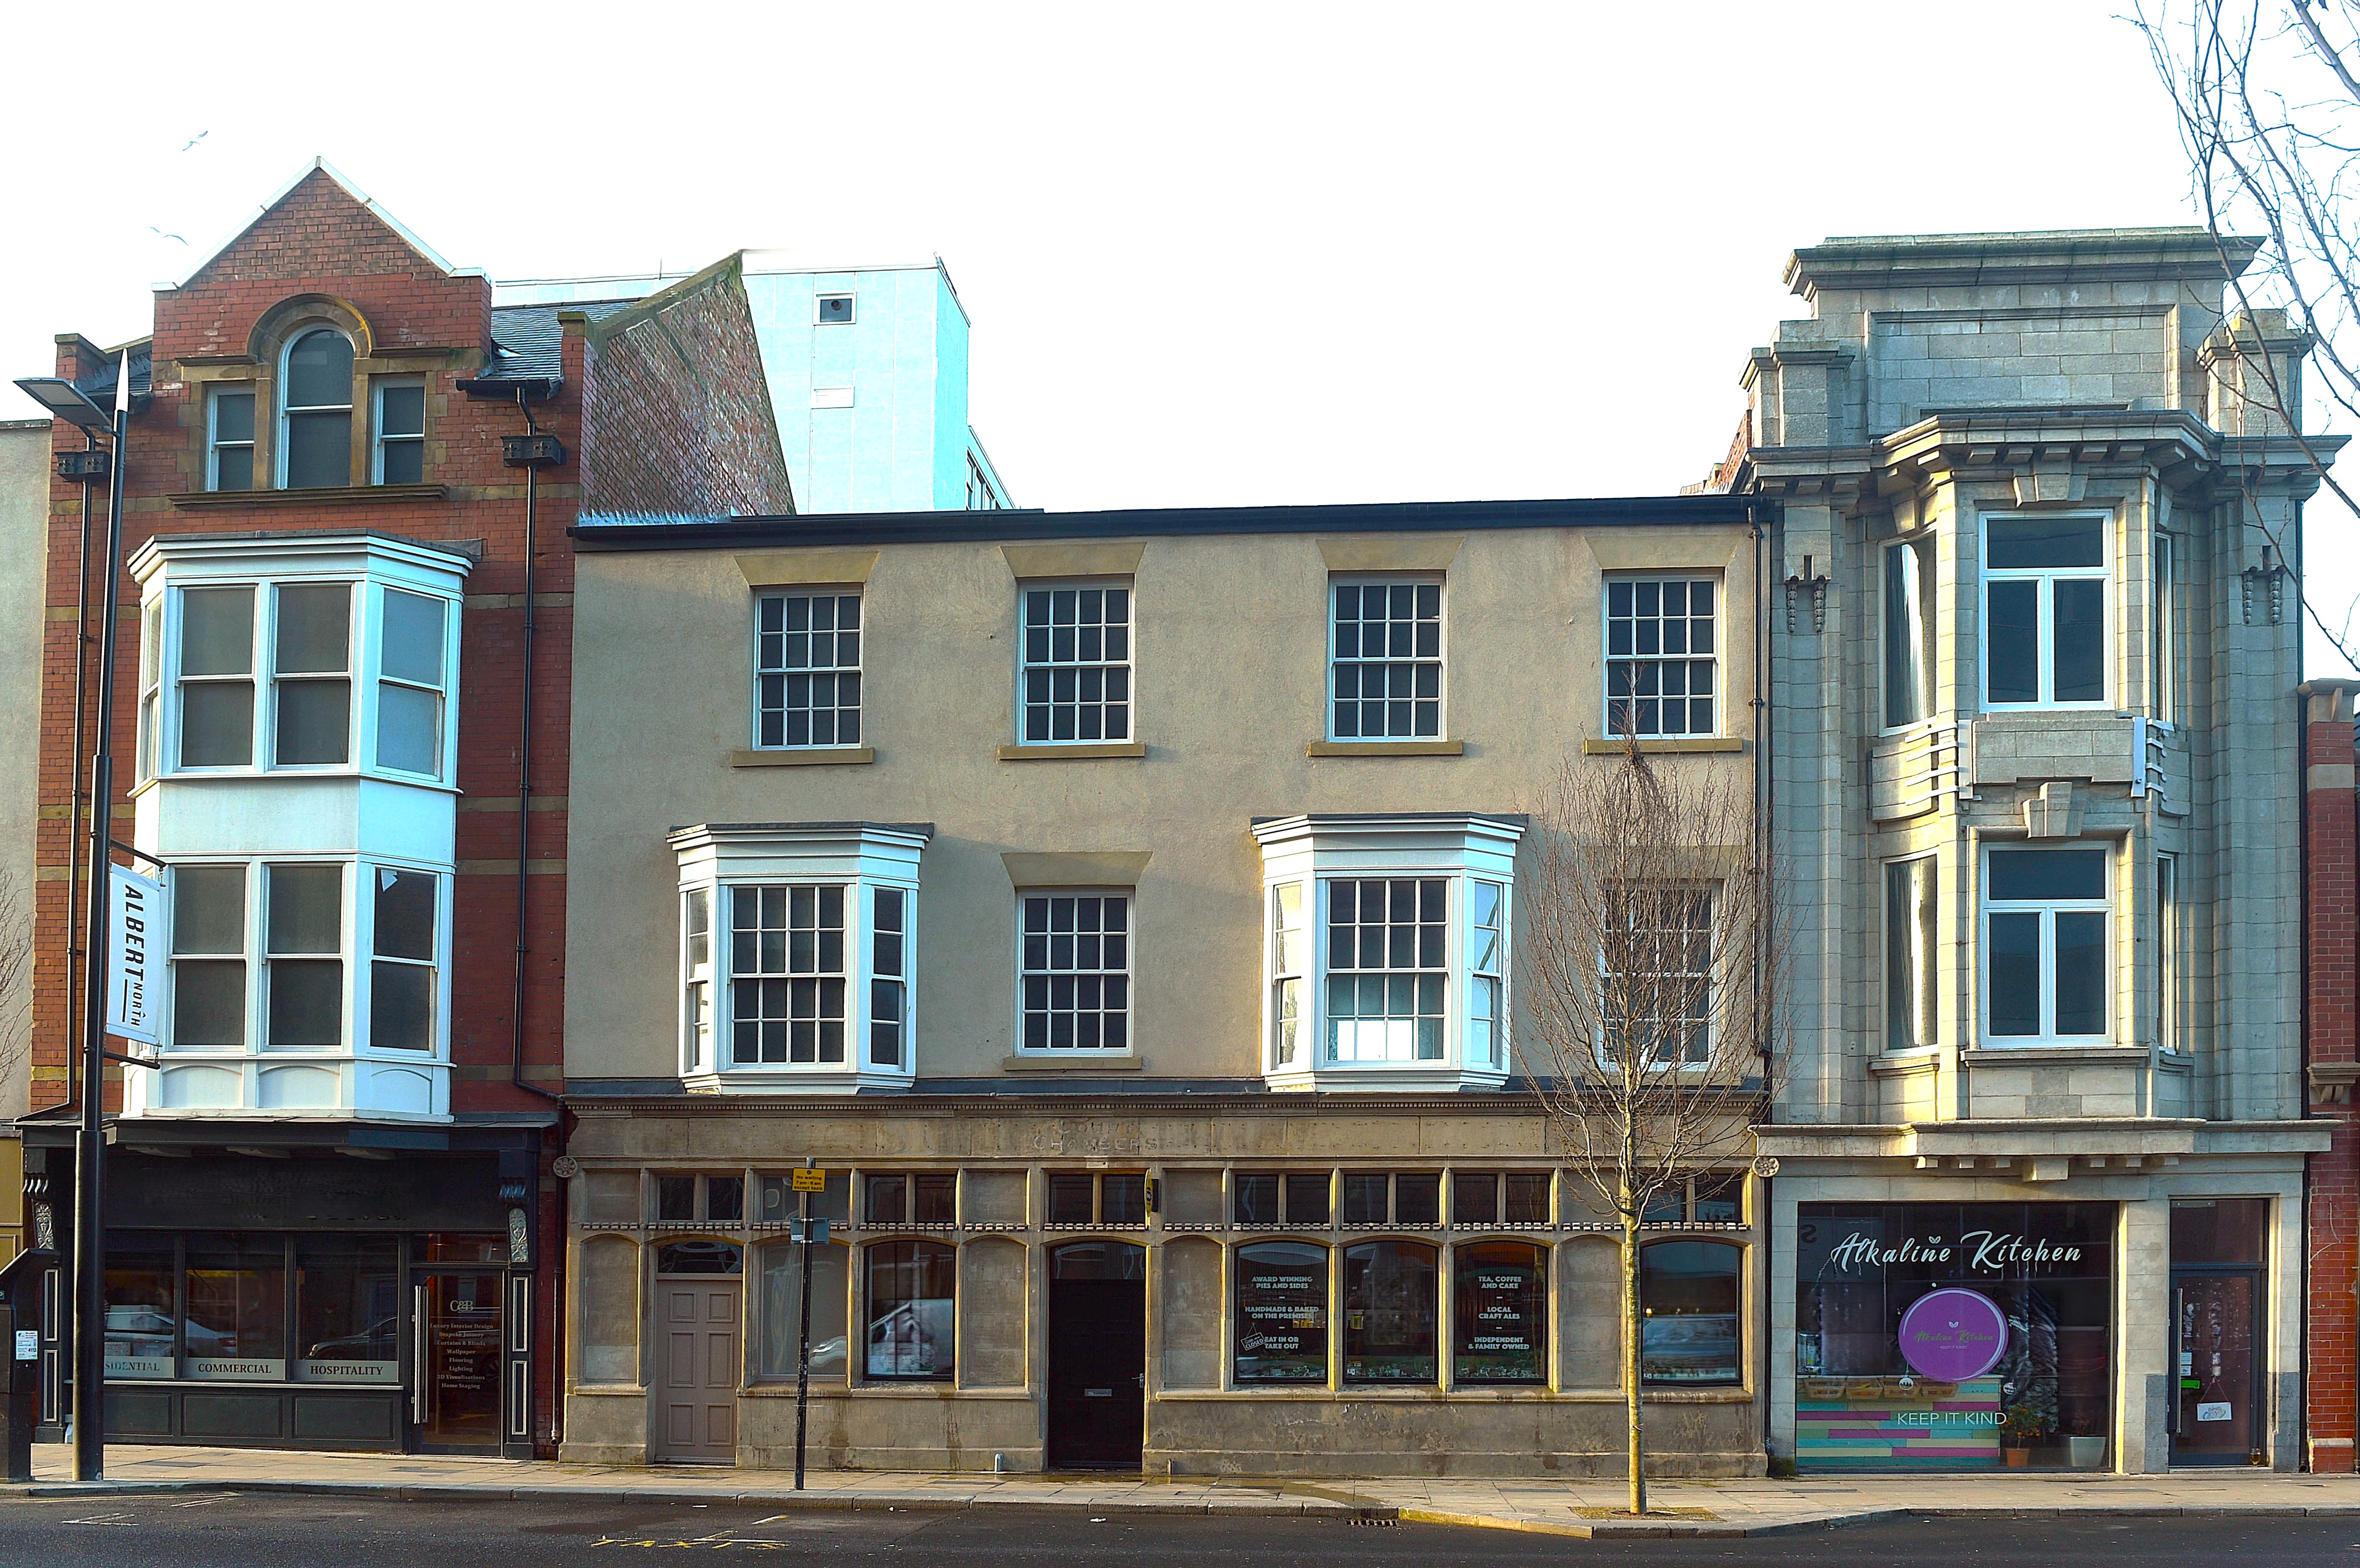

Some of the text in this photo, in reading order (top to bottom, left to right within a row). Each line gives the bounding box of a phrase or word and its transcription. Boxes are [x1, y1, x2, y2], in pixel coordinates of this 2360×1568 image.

[125, 884, 146, 1026] ALBERT NORTH
[1830, 1231, 2081, 1272] Alkaline Kitchen
[449, 1300, 473, 1312] C&B
[1245, 1338, 1264, 1349] CLOSED
[105, 1361, 160, 1372] SIDENTIAL
[197, 1363, 272, 1373] COMMERCIAL
[310, 1366, 383, 1375] HOSPITALITY
[1897, 1412, 2007, 1425] KEEP IT KIND
